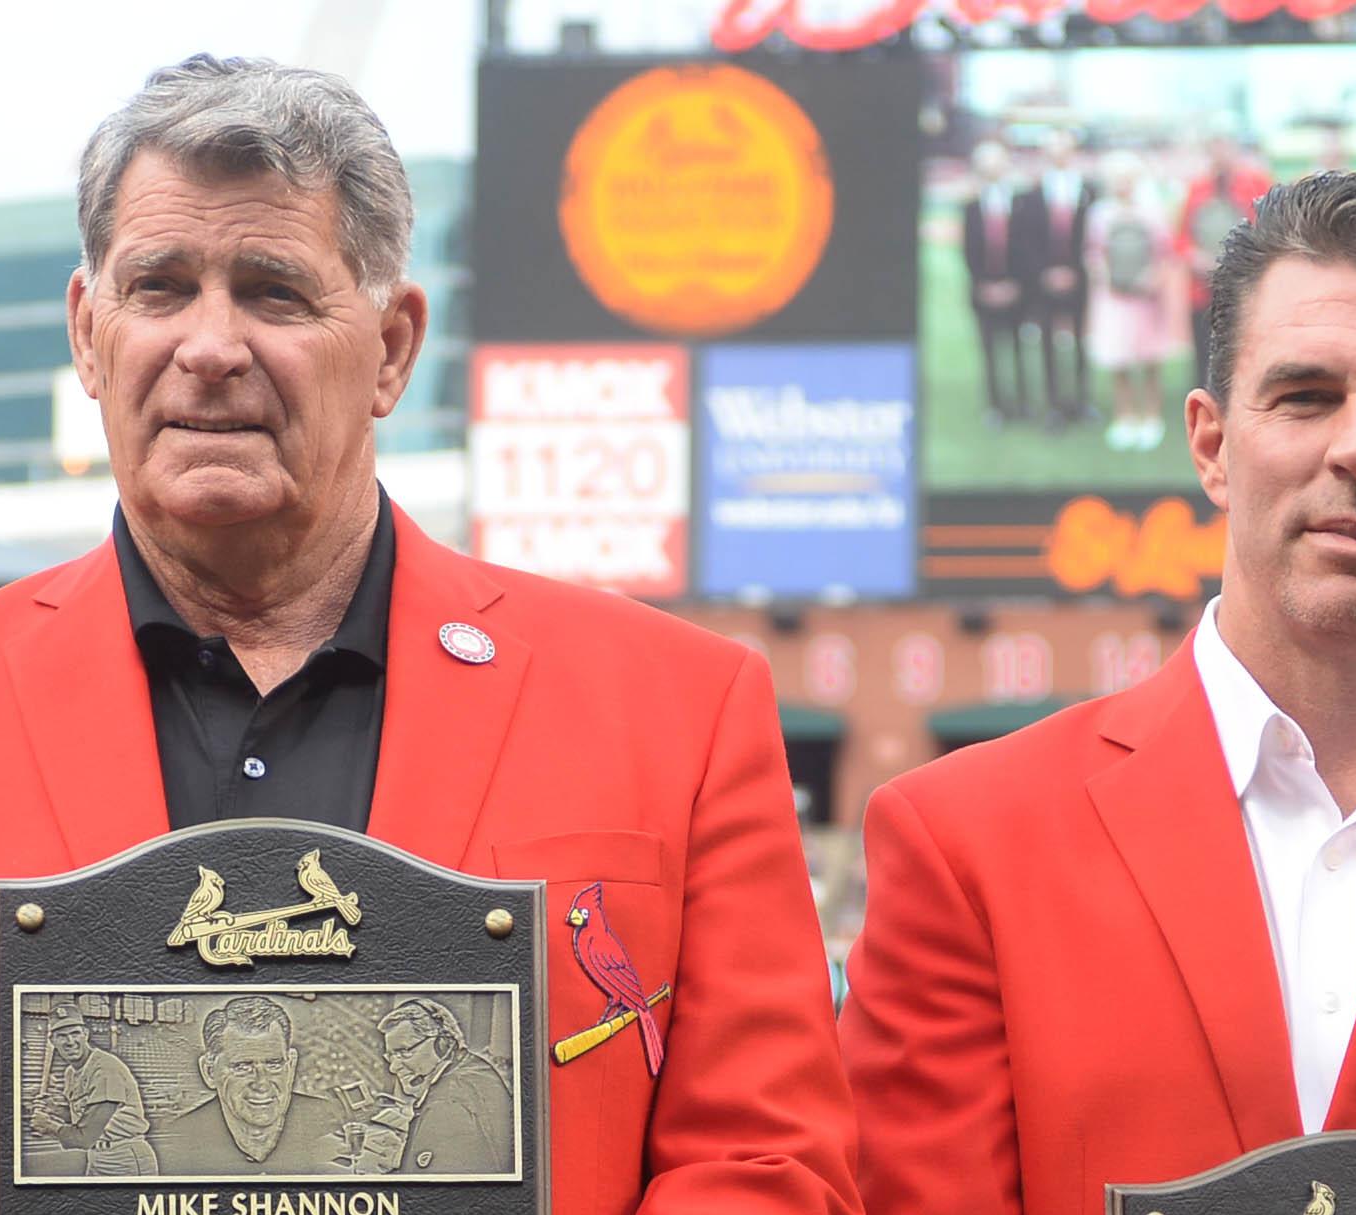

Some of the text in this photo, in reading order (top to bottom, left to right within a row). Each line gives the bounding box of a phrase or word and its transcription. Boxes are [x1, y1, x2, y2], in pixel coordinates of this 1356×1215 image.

[483, 360, 676, 418] KMOX
[706, 385, 912, 440] Webster
[498, 437, 667, 499] 1120
[198, 916, 356, 966] Cardinals
